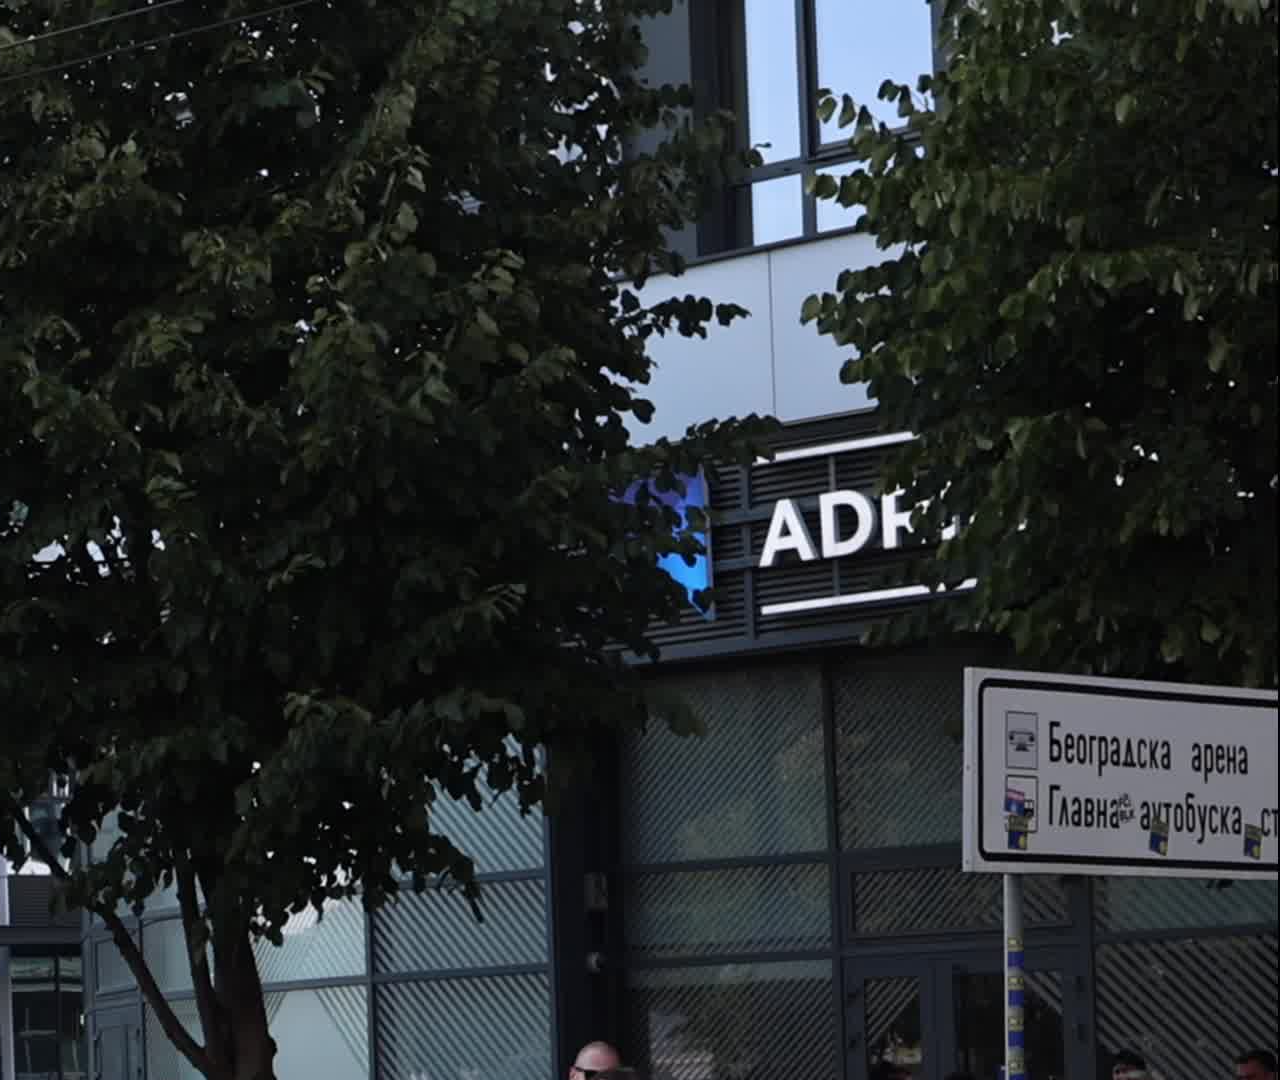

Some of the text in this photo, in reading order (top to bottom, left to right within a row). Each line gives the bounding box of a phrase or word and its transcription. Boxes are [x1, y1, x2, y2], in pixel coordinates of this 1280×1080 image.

[1048, 720, 1249, 784] Београдска арена
[1048, 784, 1120, 829] Главна
[1139, 792, 1242, 844] аутобуска
